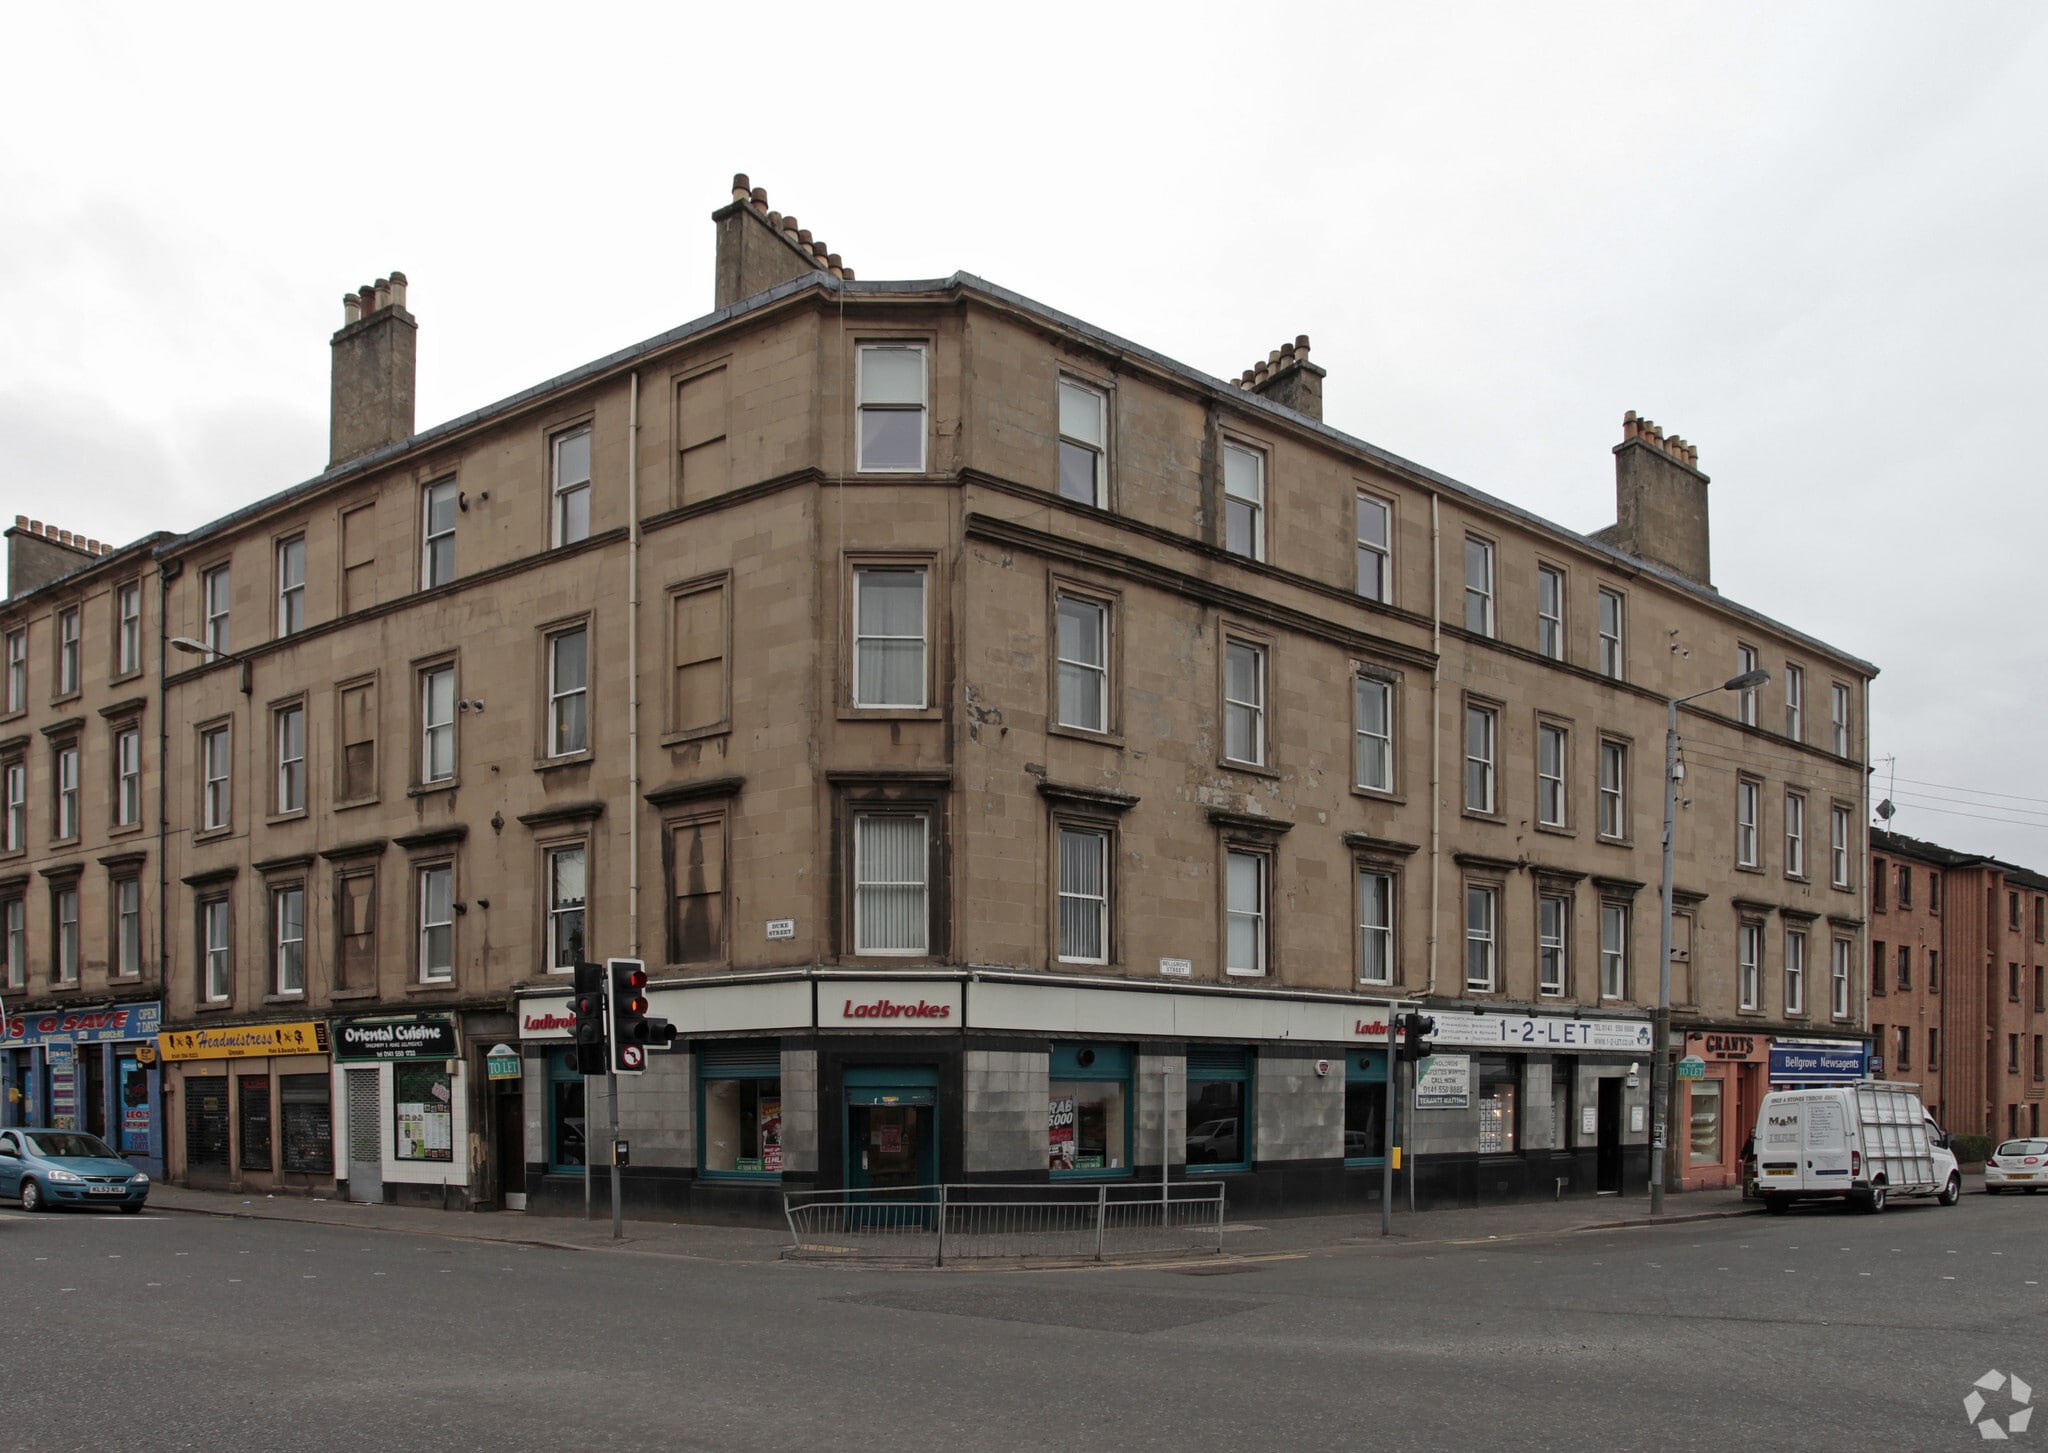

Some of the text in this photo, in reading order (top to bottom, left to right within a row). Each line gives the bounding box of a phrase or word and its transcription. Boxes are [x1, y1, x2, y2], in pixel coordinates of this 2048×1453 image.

[139, 1008, 157, 1019] OPEN
[843, 1000, 950, 1018] Ladbrokes
[38, 1017, 58, 1032] Q
[61, 1010, 130, 1031] SAVE
[136, 1021, 159, 1033] 7 DAYS
[524, 1012, 577, 1030] Ladbrok
[196, 1031, 273, 1048] Headmistress
[345, 1025, 441, 1042] Oriental Cuisine
[1500, 1020, 1591, 1043] 1-2-LET
[1706, 1035, 1753, 1054] GRANTS
[489, 1062, 516, 1073] TO LET
[1679, 1068, 1689, 1076] TO
[1690, 1068, 1703, 1076] LET
[1785, 1056, 1859, 1071] Bellgrove Newsagents
[1768, 1116, 1797, 1126] M&M
